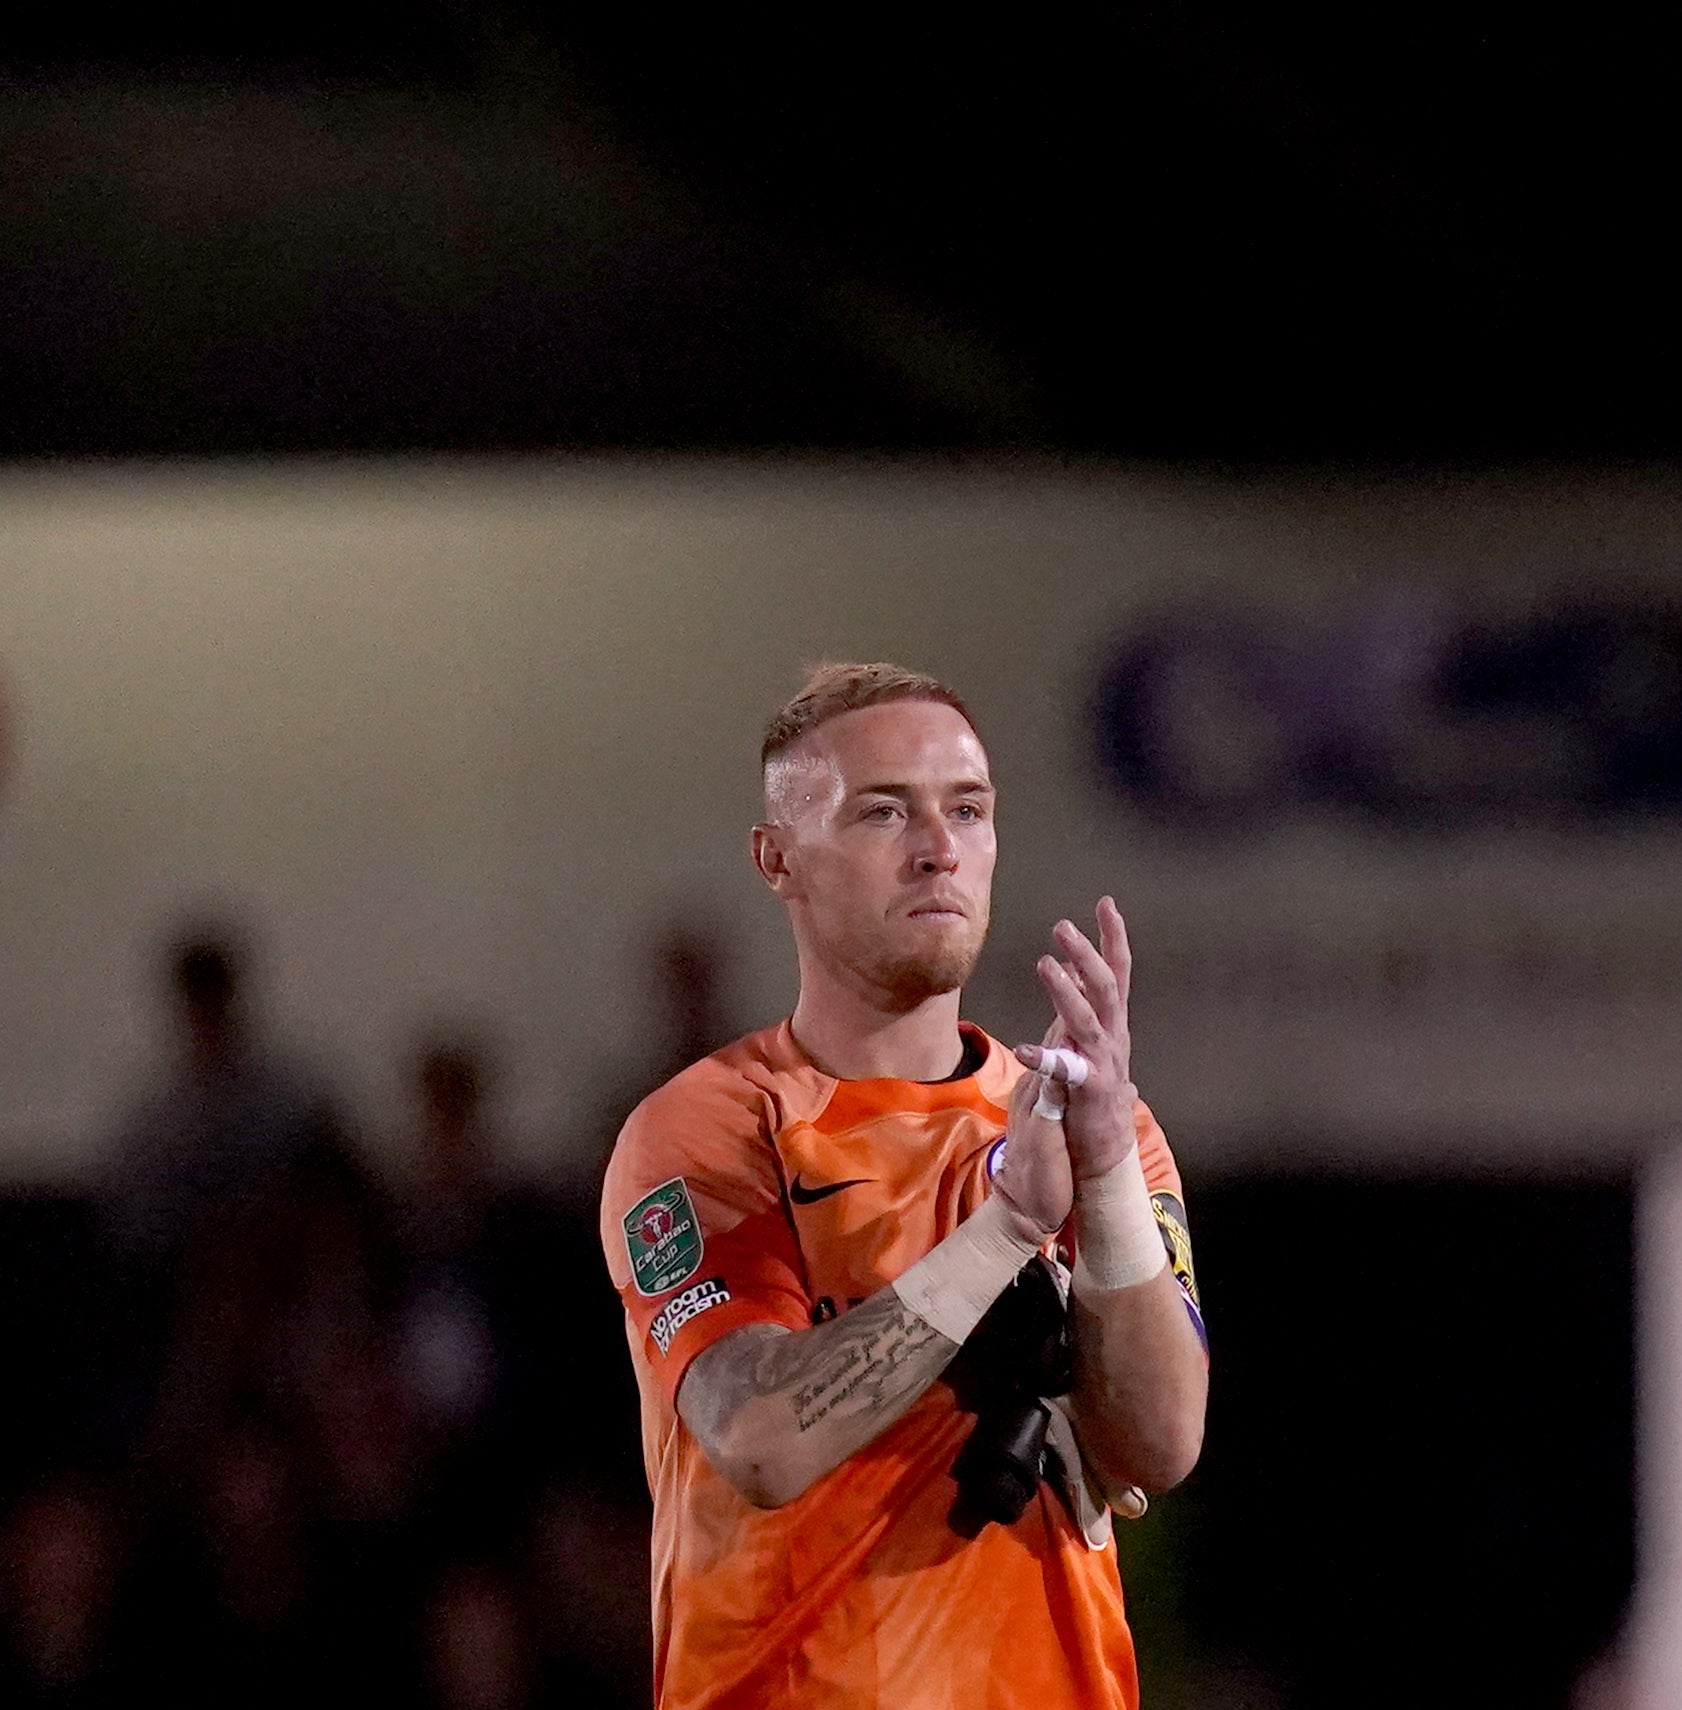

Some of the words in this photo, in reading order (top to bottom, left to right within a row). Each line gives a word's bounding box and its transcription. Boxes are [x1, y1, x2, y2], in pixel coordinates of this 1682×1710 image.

[652, 1244, 679, 1272] Cup
[664, 1280, 718, 1321] room
[669, 1290, 732, 1336] racism
